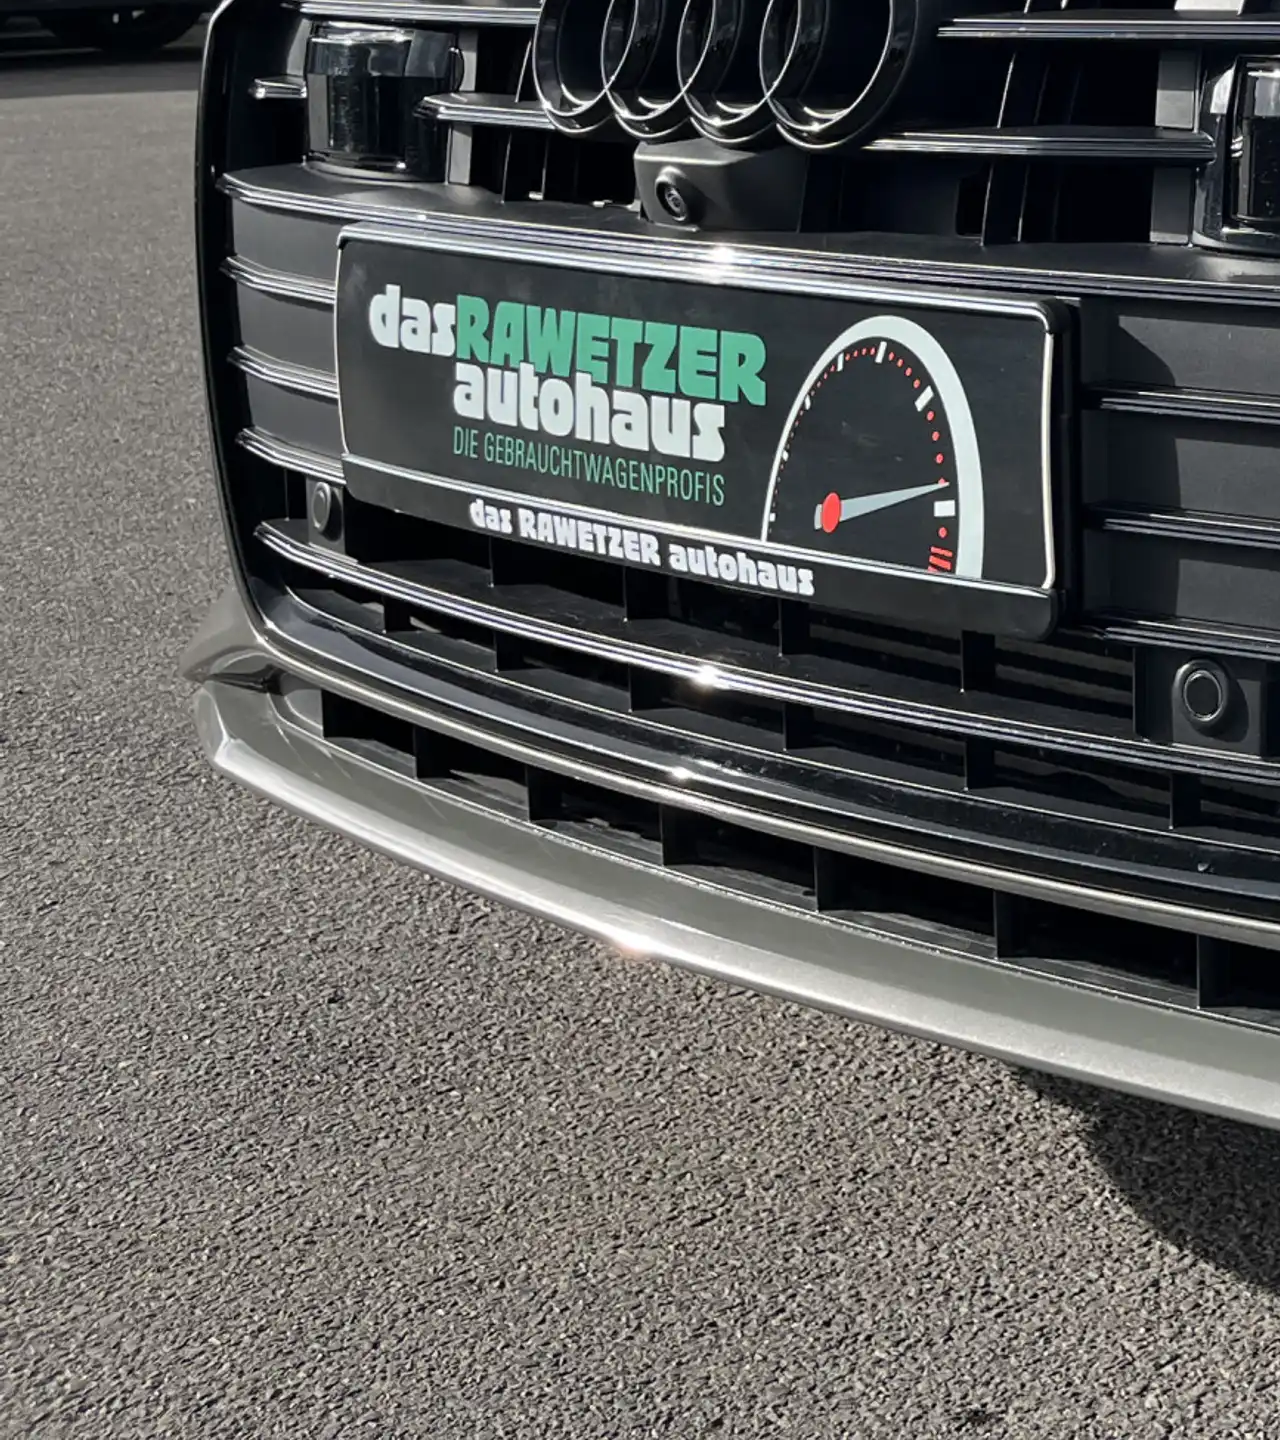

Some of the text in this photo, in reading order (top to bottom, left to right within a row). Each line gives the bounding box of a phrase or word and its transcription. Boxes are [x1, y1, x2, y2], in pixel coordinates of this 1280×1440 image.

[453, 362, 725, 462] autohaus
[453, 426, 725, 507] DIE GEBRAUCHTWAGENPROFIS
[469, 498, 815, 596] das RAWETZER autohaus
